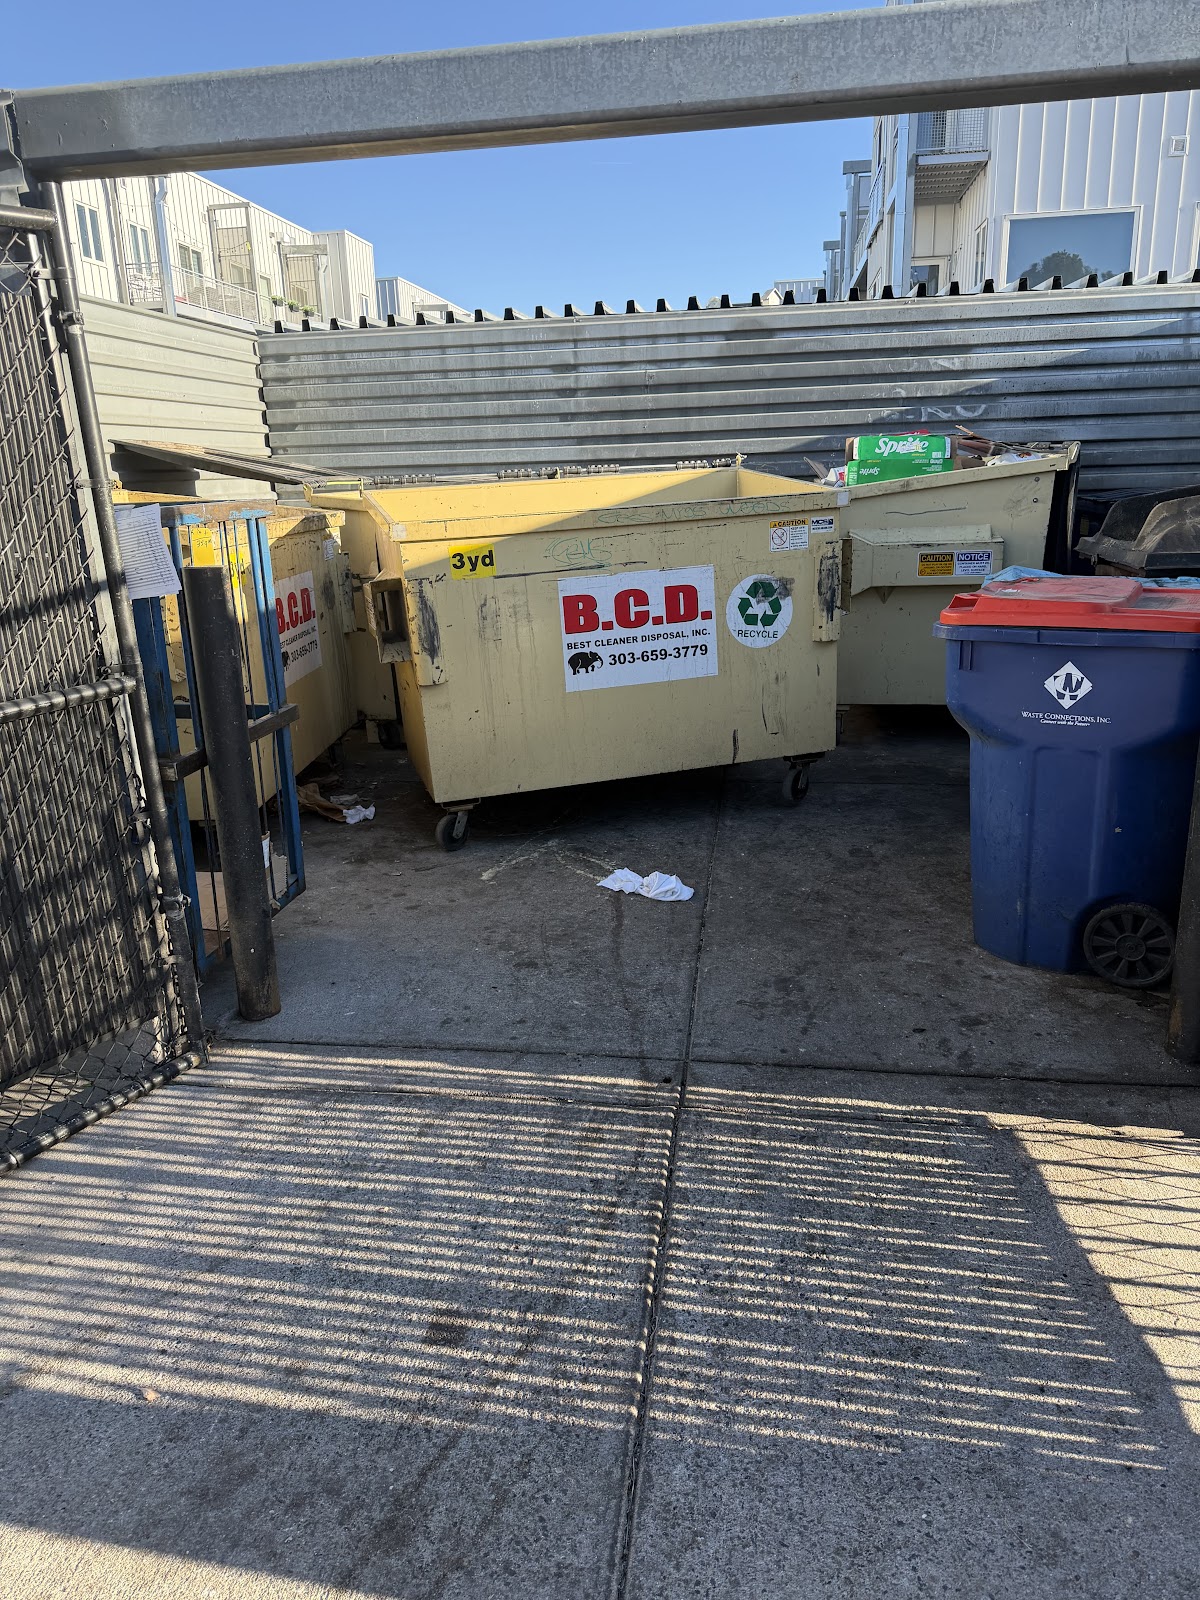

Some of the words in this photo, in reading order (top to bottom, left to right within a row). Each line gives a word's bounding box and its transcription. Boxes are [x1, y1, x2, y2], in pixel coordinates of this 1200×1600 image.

[875, 437, 929, 457] Sprite
[859, 467, 880, 476] Sprite
[777, 519, 806, 527] CAUTION
[452, 550, 494, 572] 3yd
[958, 553, 989, 561] NOTICE
[275, 588, 316, 635] B.C.D.
[562, 584, 713, 635] B.C.D.
[566, 641, 592, 650] BEST
[594, 636, 639, 648] CLEANER
[641, 630, 689, 643] DISPOSAL,
[692, 628, 711, 636] INC.
[737, 630, 779, 639] RECYCLE
[608, 644, 708, 666] 303-659-3779
[1021, 711, 1044, 719] WASTE
[1044, 712, 1096, 723] CONNECTIONS,
[1097, 716, 1112, 724] INC.
